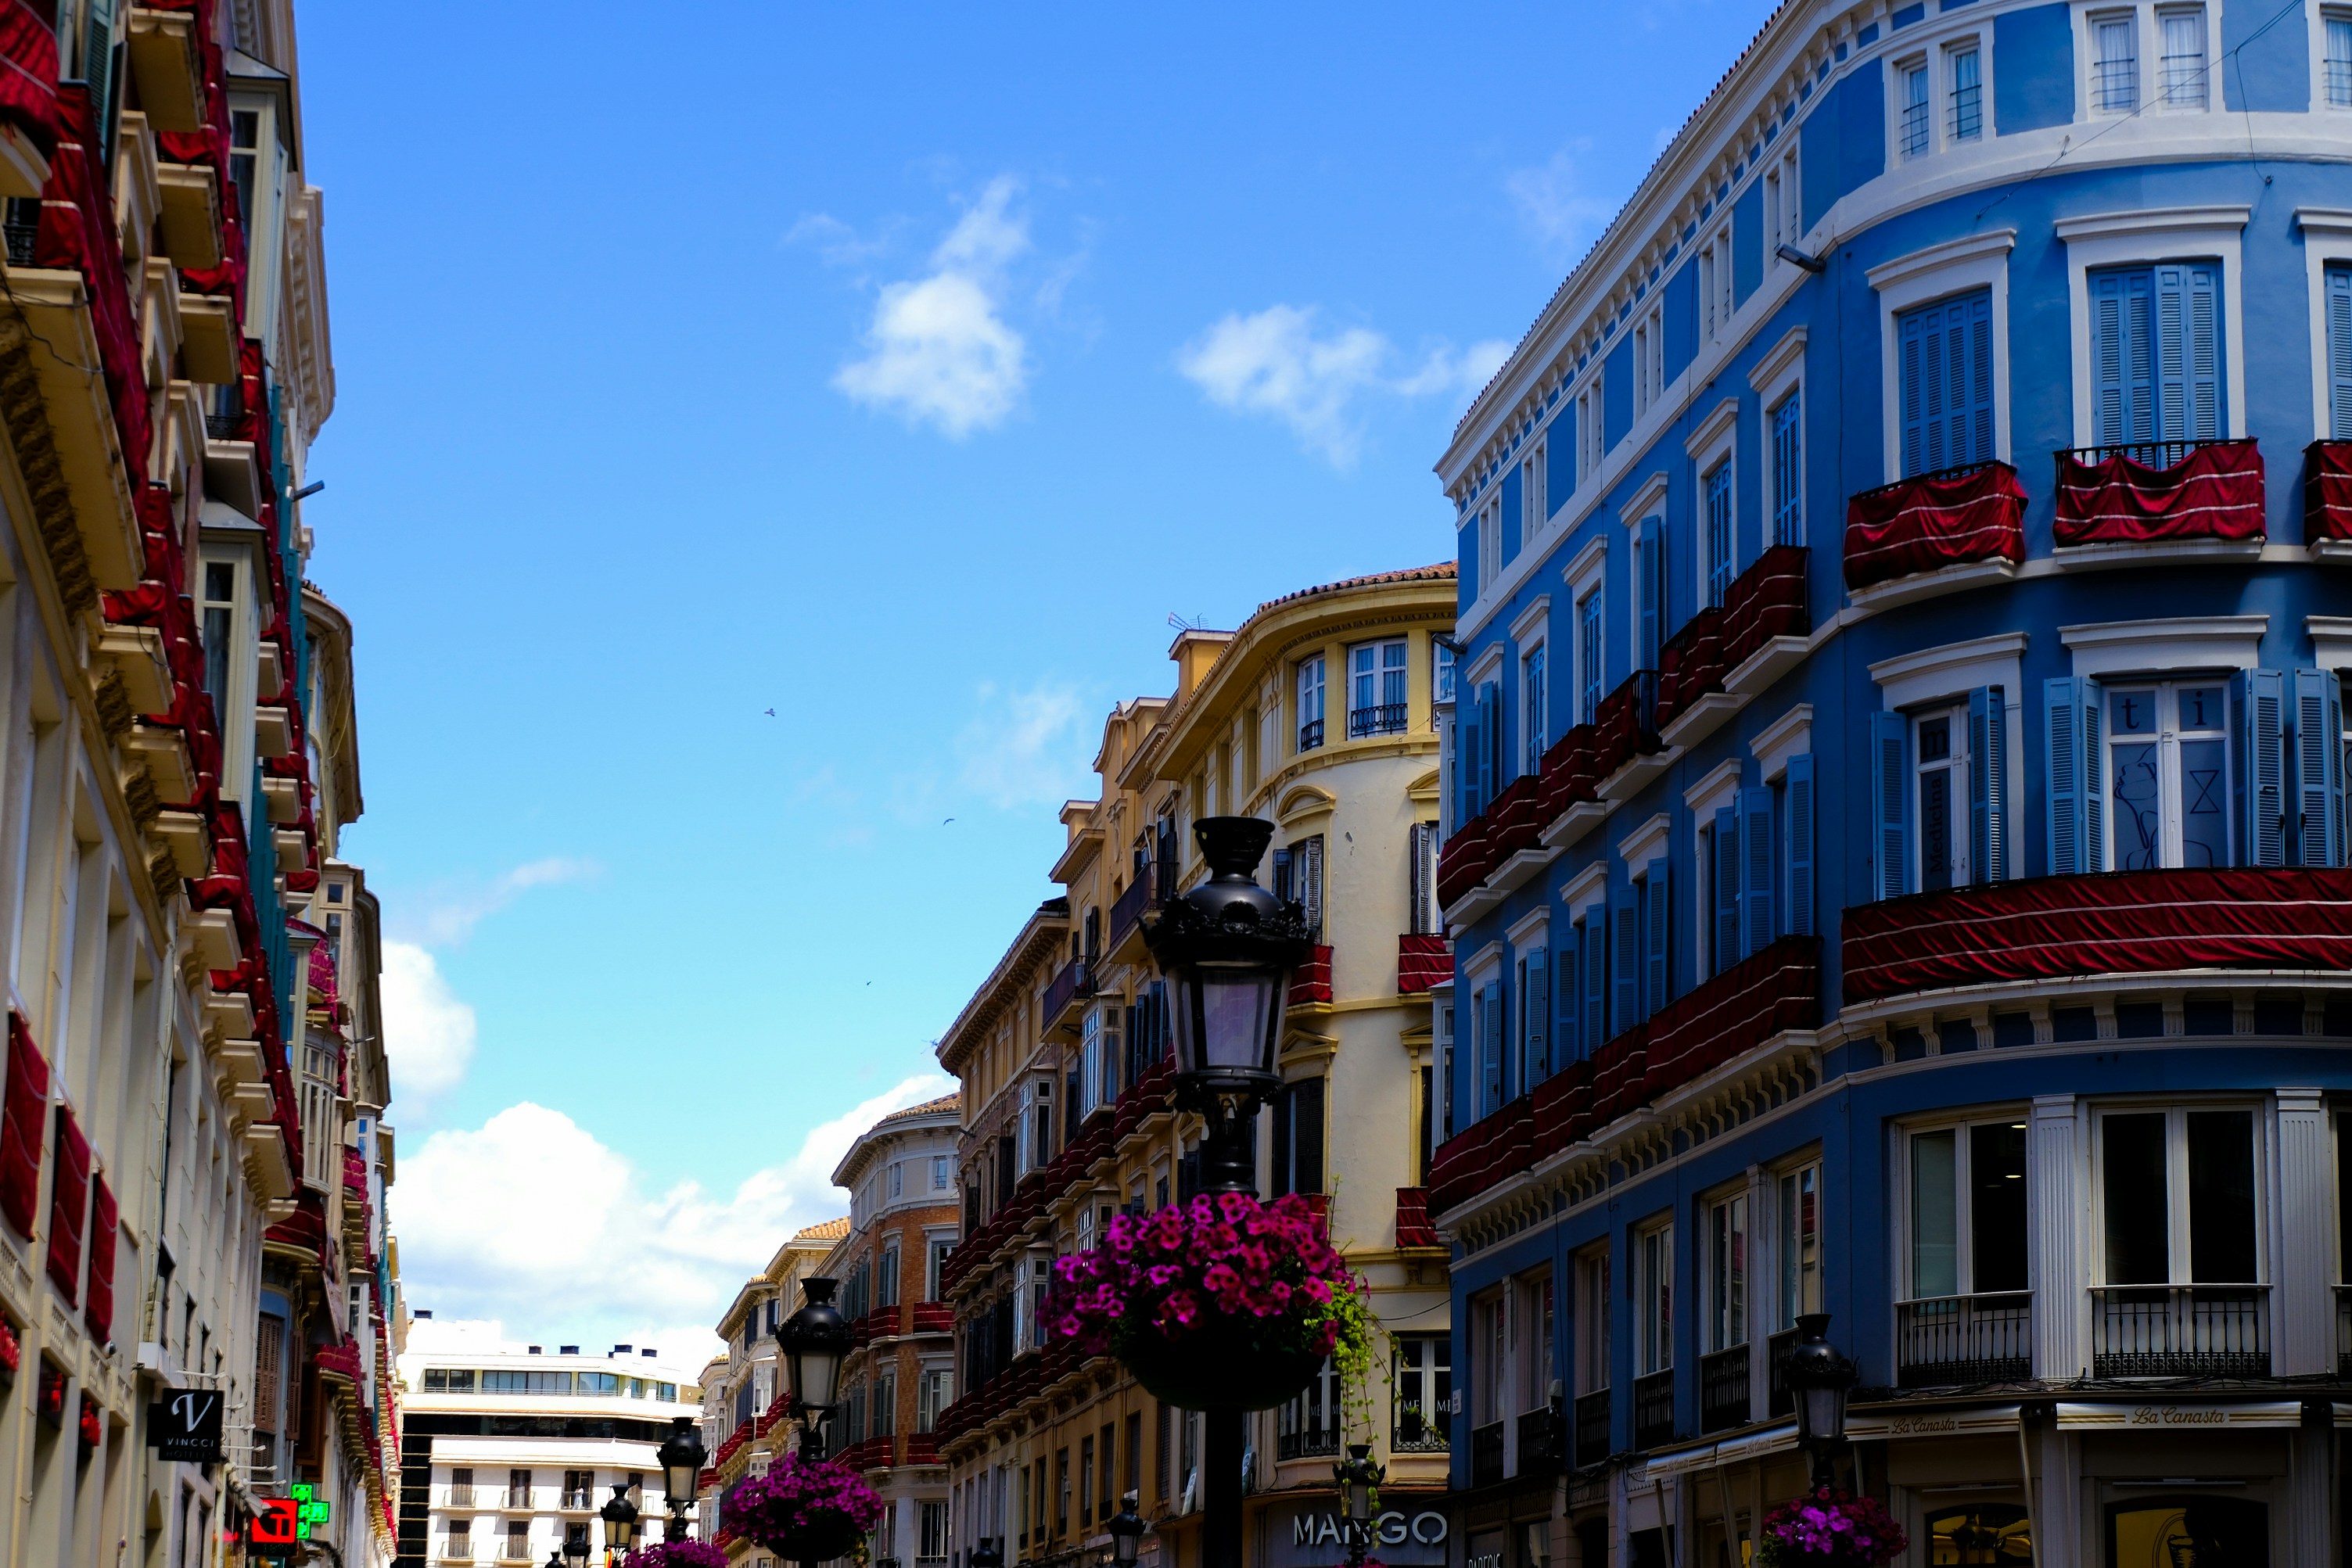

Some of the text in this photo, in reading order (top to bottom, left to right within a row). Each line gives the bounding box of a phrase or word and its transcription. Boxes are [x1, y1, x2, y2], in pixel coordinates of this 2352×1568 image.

[1929, 775, 1943, 874] Medicina
[2132, 1407, 2225, 1424] La Canasta
[1891, 1416, 1955, 1434] La Canasta
[166, 1438, 214, 1448] VINCCI
